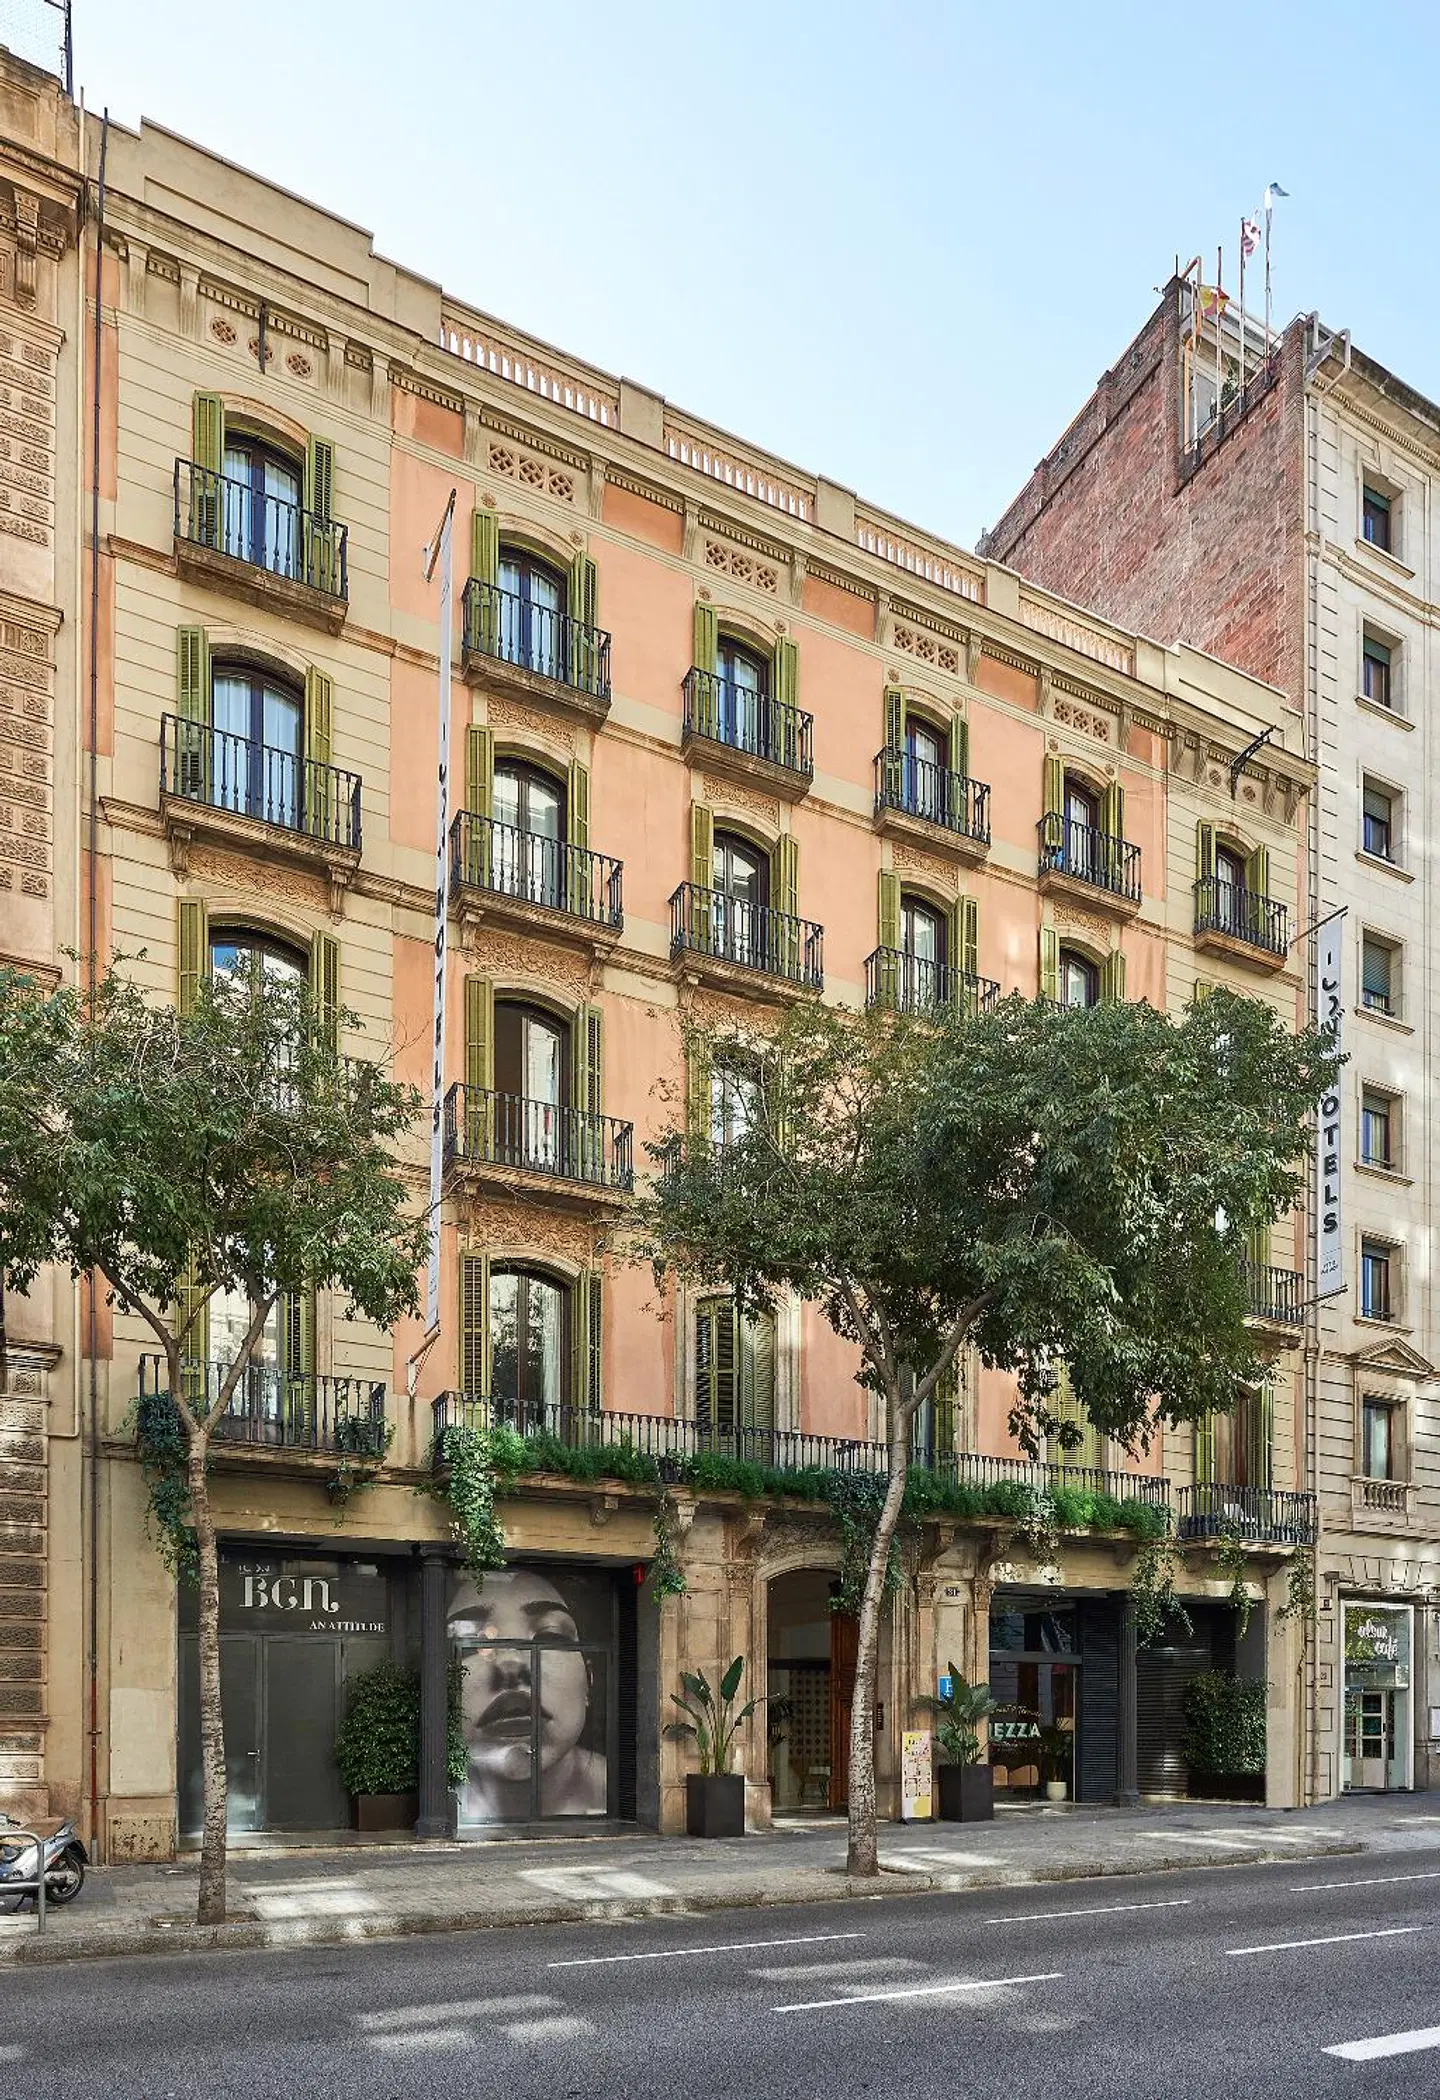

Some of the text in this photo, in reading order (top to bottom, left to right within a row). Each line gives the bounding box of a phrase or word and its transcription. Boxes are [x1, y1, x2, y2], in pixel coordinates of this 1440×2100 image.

[432, 879, 445, 1134] HOTELS
[1322, 1095, 1340, 1235] OTELS
[309, 1620, 385, 1633] AN ATTITUDE
[989, 1722, 1042, 1738] EZZA
